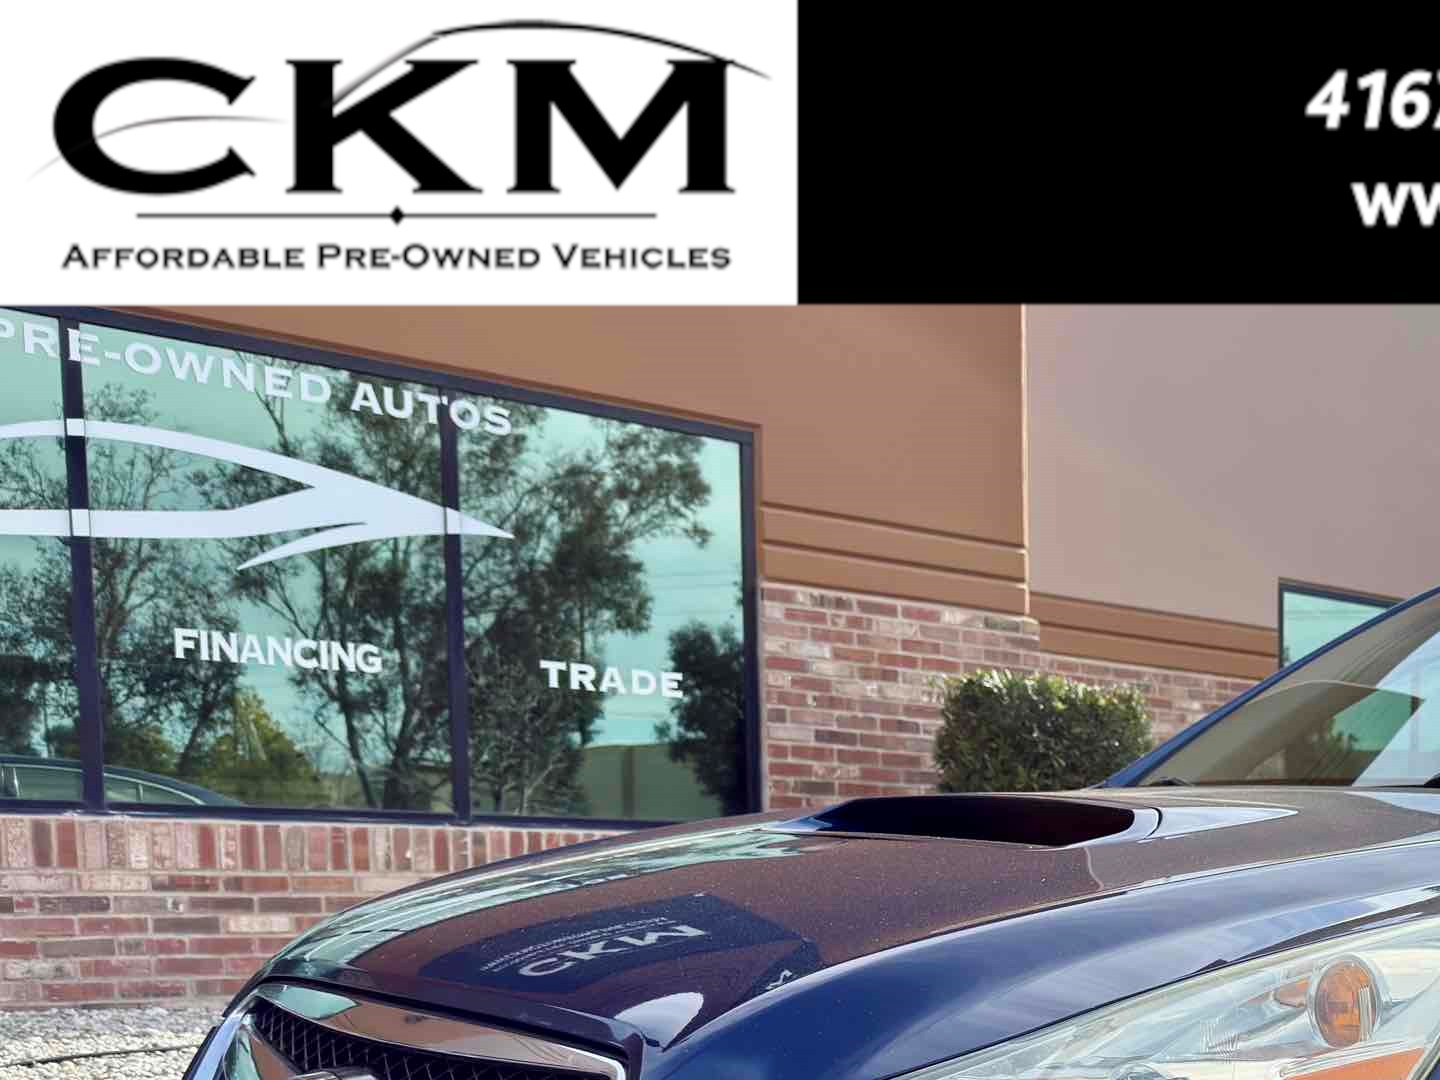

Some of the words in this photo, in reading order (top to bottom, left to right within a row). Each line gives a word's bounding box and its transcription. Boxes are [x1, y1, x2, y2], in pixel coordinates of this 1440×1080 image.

[350, 381, 513, 436] AUTOS
[173, 627, 383, 674] FINANCING
[538, 659, 684, 700] TRADE
